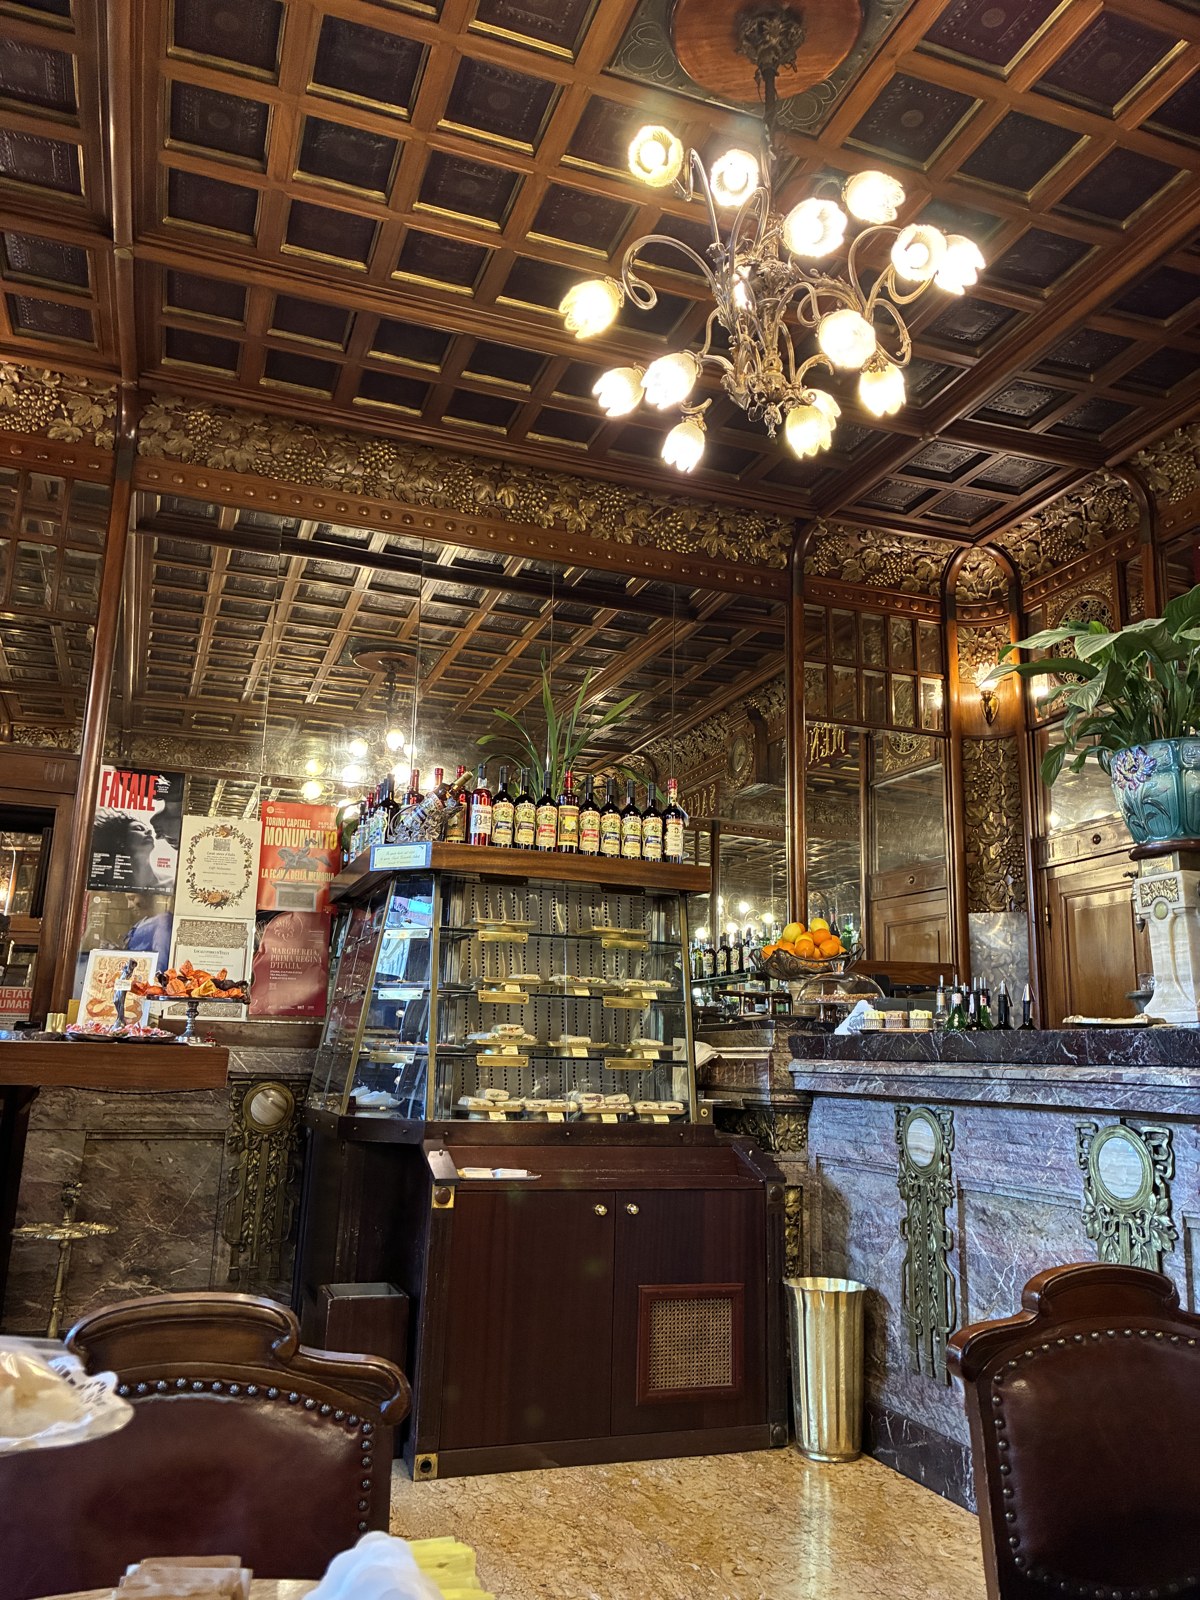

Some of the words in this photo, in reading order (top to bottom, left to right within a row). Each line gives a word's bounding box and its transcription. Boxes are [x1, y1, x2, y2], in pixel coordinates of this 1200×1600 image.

[100, 771, 158, 811] FATALE
[266, 816, 286, 827] TORINO
[287, 818, 311, 829] CAPITALE
[264, 826, 338, 851] MONUMENTO
[261, 868, 269, 879] LA
[290, 869, 307, 881] DELLA
[271, 947, 320, 957] MARGHERITA,
[270, 954, 293, 962] PRIMA
[0, 989, 33, 999] IETAT
[0, 999, 30, 1009] UMAR
